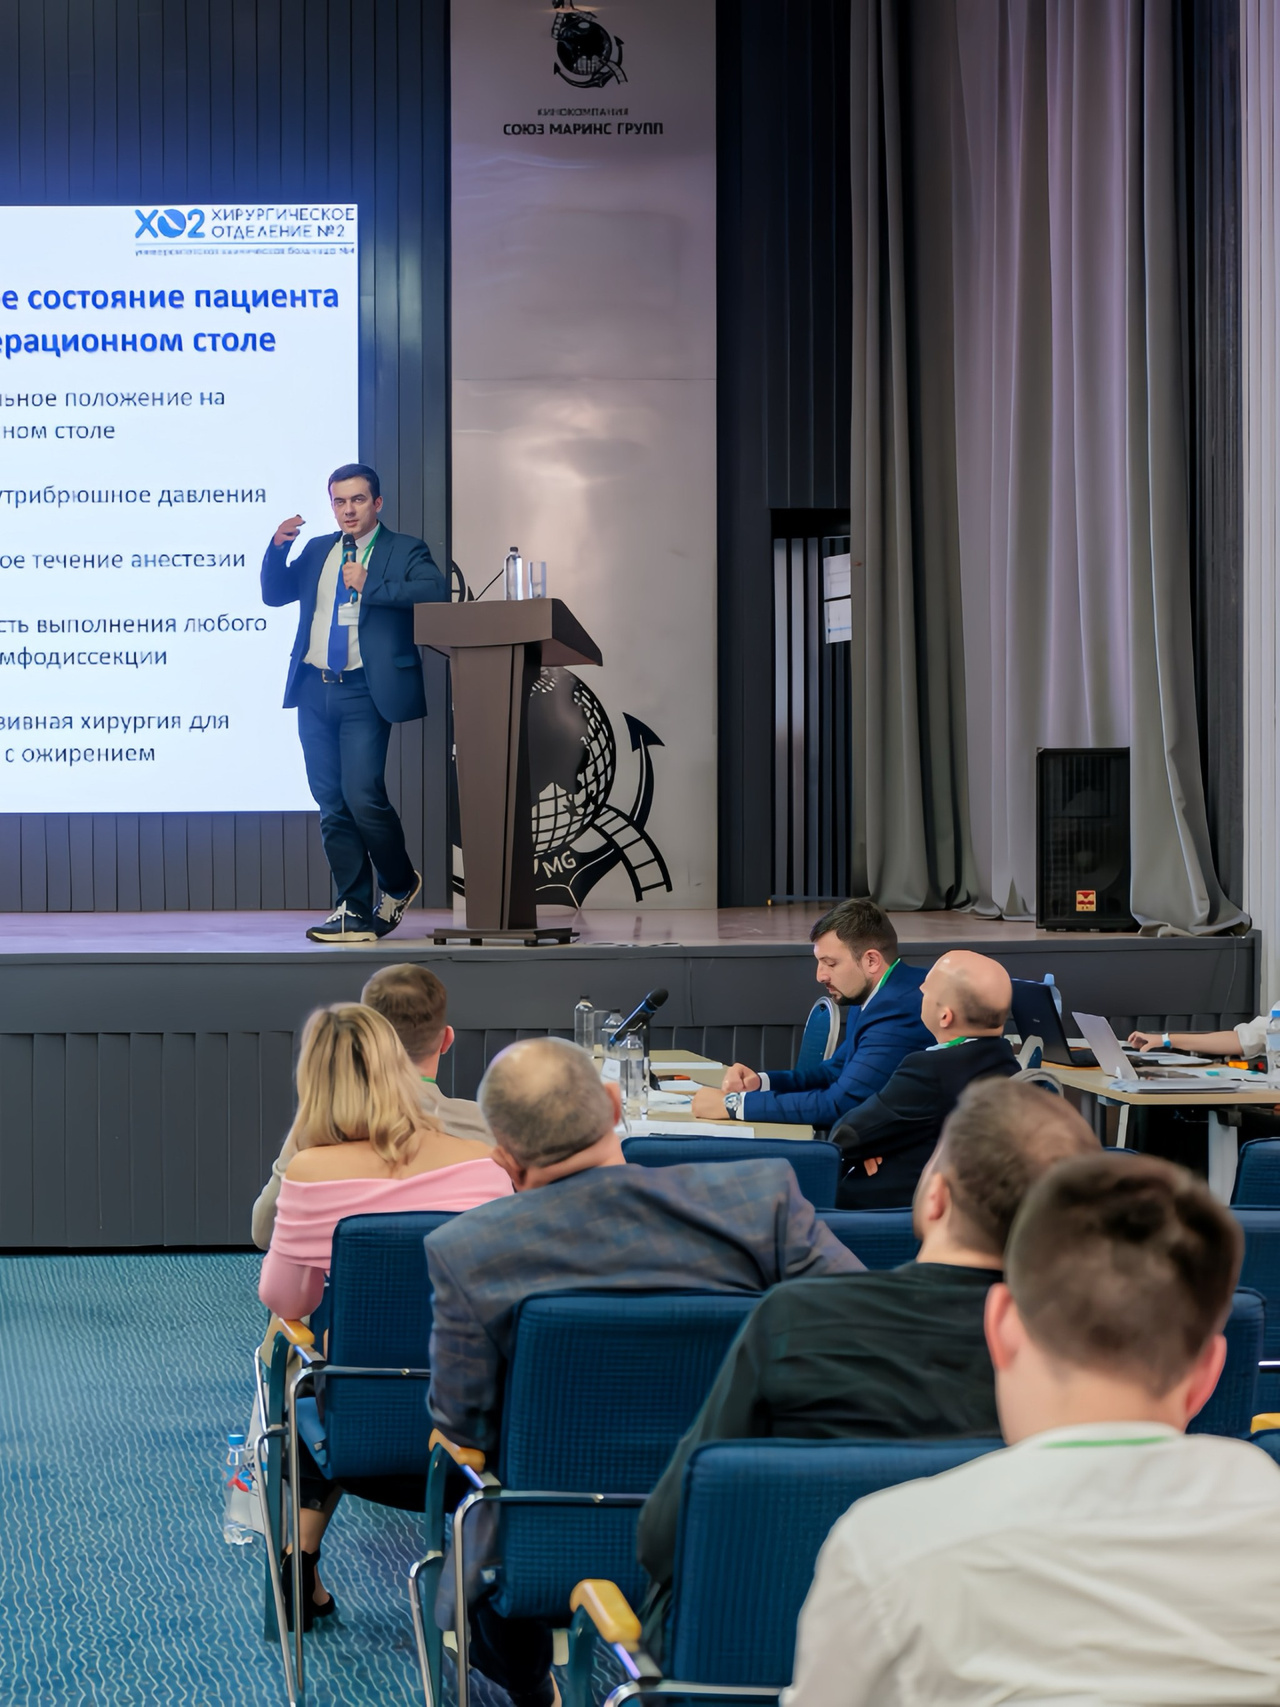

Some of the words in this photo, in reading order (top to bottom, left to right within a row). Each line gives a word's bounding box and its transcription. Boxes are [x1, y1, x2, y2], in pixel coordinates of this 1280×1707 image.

[503, 123, 544, 136] СОЮЗ
[549, 122, 613, 136] МАРИНС
[617, 122, 664, 135] ГРУПП
[211, 207, 355, 221] ХИРУРГИЧЕСКОЕ
[211, 224, 312, 240] ОТДЕЛЕНИЕ
[27, 289, 185, 311] состояние
[194, 287, 339, 315] пациента
[192, 331, 277, 354] столе
[65, 391, 193, 408] положение
[199, 391, 225, 406] на
[55, 424, 116, 440] столе
[157, 487, 267, 508] давления
[32, 553, 124, 569] течение
[131, 552, 246, 569] анестезии
[37, 616, 177, 634] выполнения
[184, 613, 267, 633] любого
[80, 714, 182, 735] хирургия
[188, 714, 230, 734] для
[5, 747, 15, 764] с
[21, 747, 156, 768] ожирением
[542, 850, 577, 878] MG
